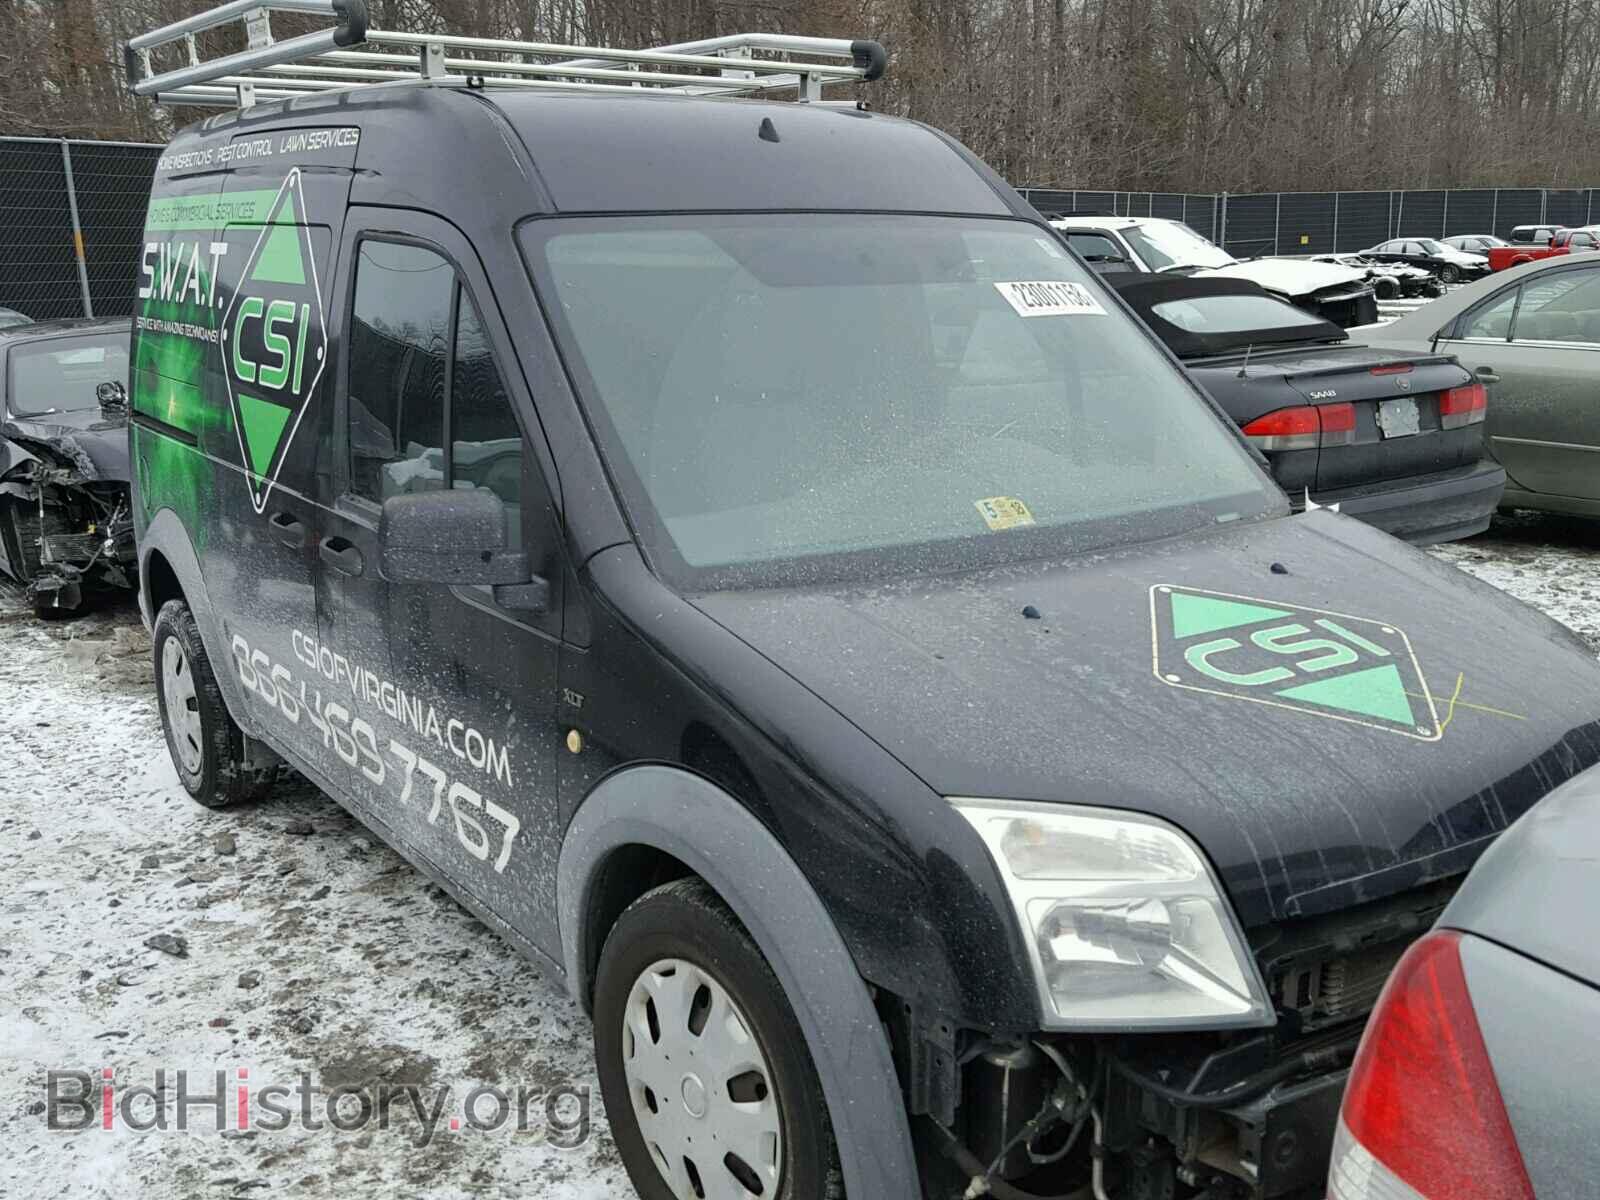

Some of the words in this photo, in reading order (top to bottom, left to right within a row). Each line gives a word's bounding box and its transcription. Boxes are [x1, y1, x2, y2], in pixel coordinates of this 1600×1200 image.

[218, 144, 237, 161] PEST
[235, 138, 272, 160] CONTROL
[280, 134, 309, 154] LAWN
[307, 128, 360, 150] SERVICES
[215, 201, 256, 220] SERVICES
[139, 242, 228, 309] S.W.A.T.
[232, 297, 310, 395] CSI
[1310, 390, 1336, 400] SAAB
[1184, 618, 1391, 686] CSI
[292, 629, 513, 788] CSIOFVIRGINIA.COM
[299, 681, 386, 786] 469
[389, 739, 520, 874] 7767
